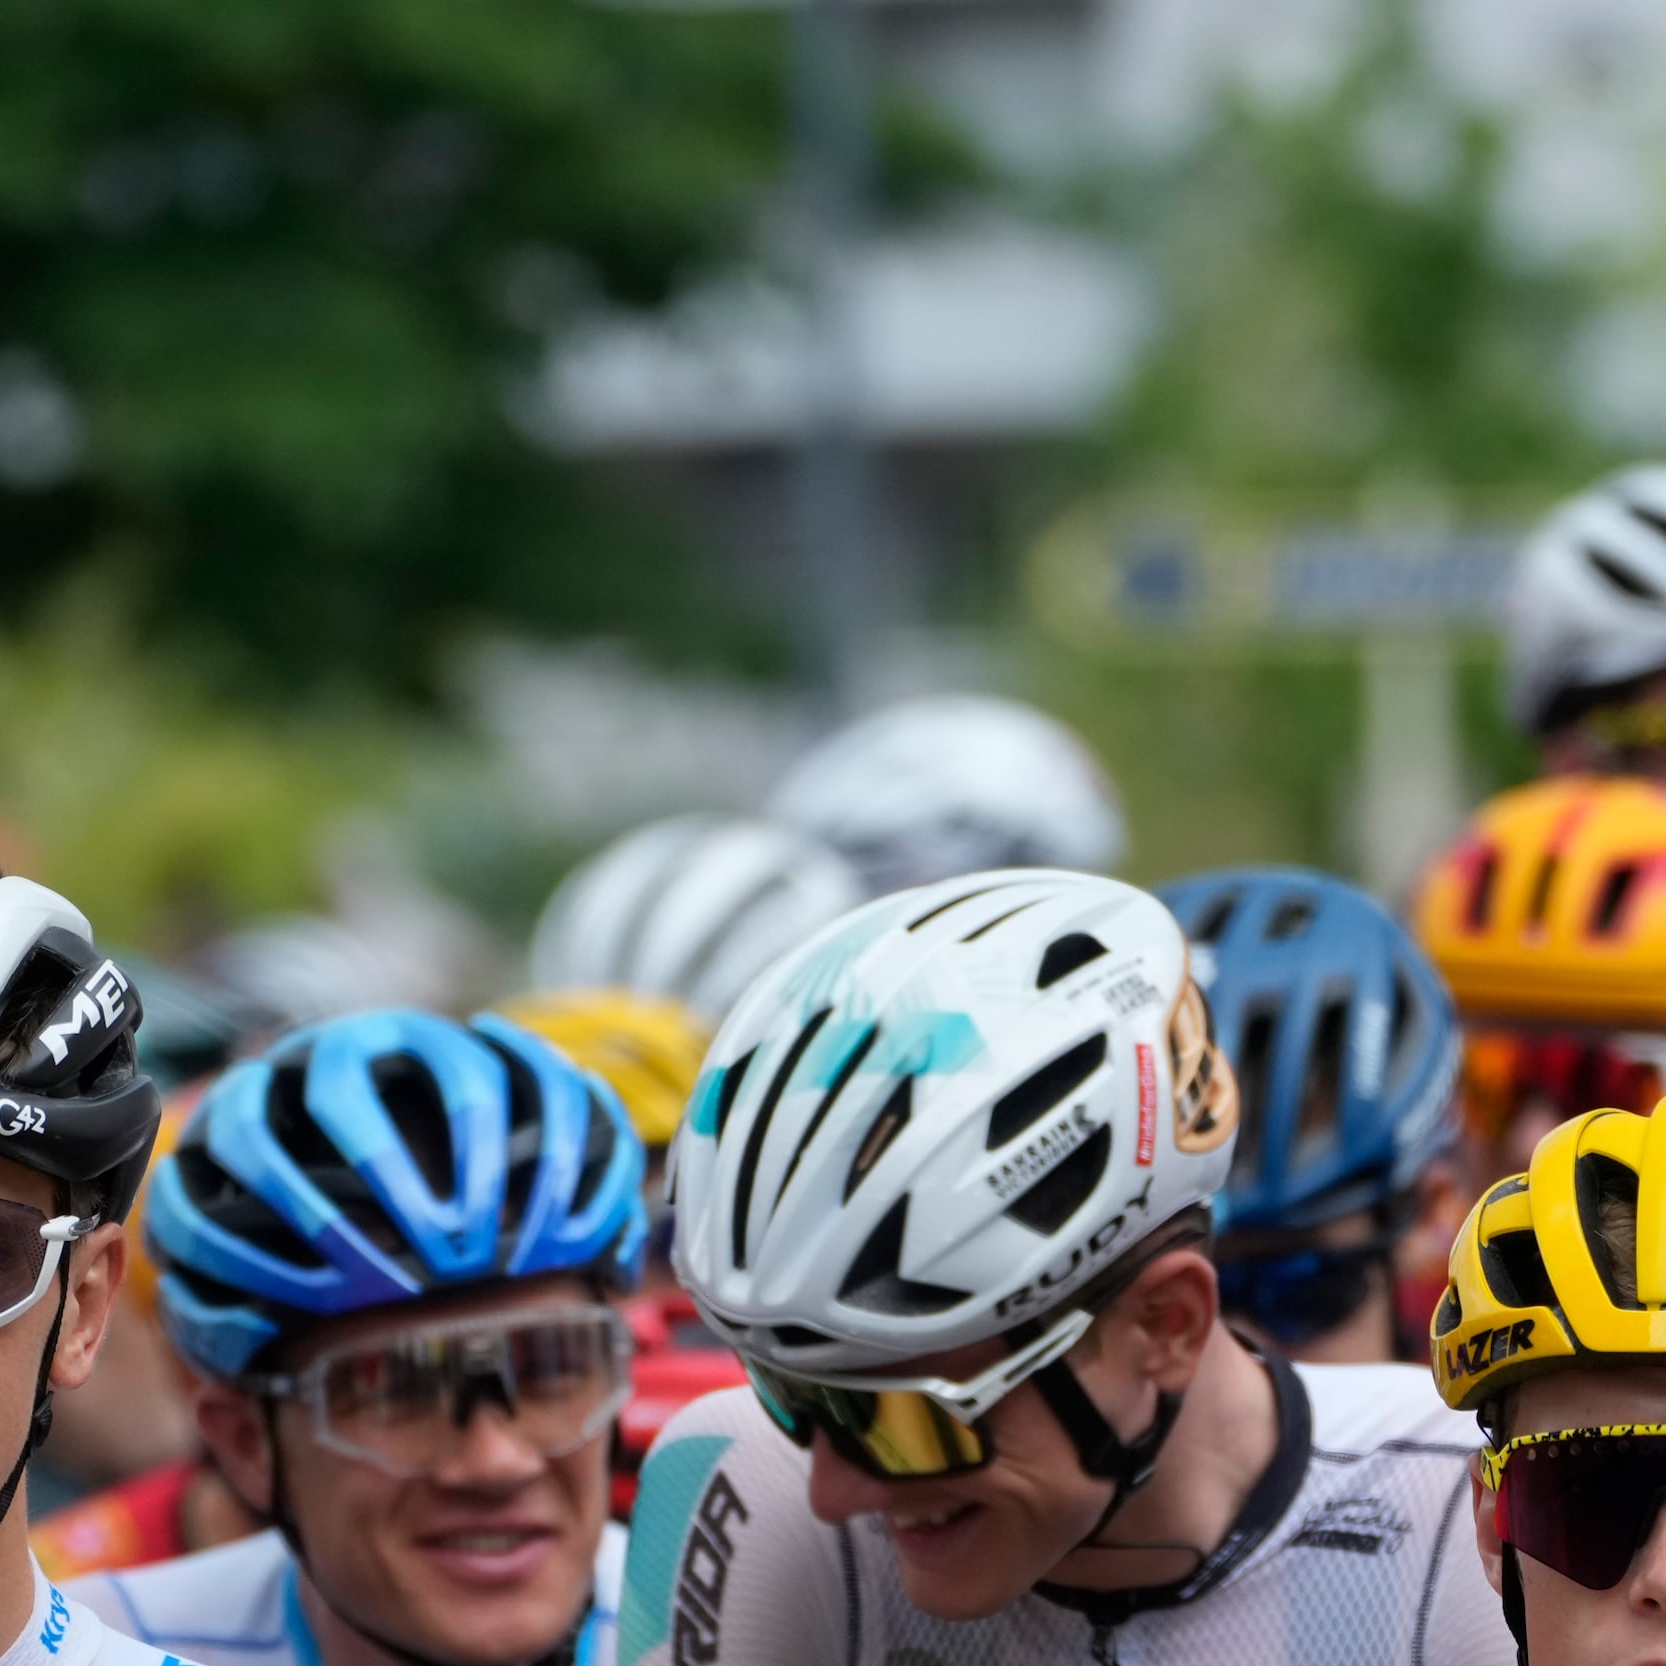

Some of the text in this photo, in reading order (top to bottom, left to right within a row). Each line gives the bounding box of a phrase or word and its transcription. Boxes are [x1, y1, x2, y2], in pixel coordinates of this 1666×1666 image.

[39, 959, 130, 1065] MET
[995, 1175, 1154, 1318] RUDY
[1445, 1319, 1536, 1381] LAZER
